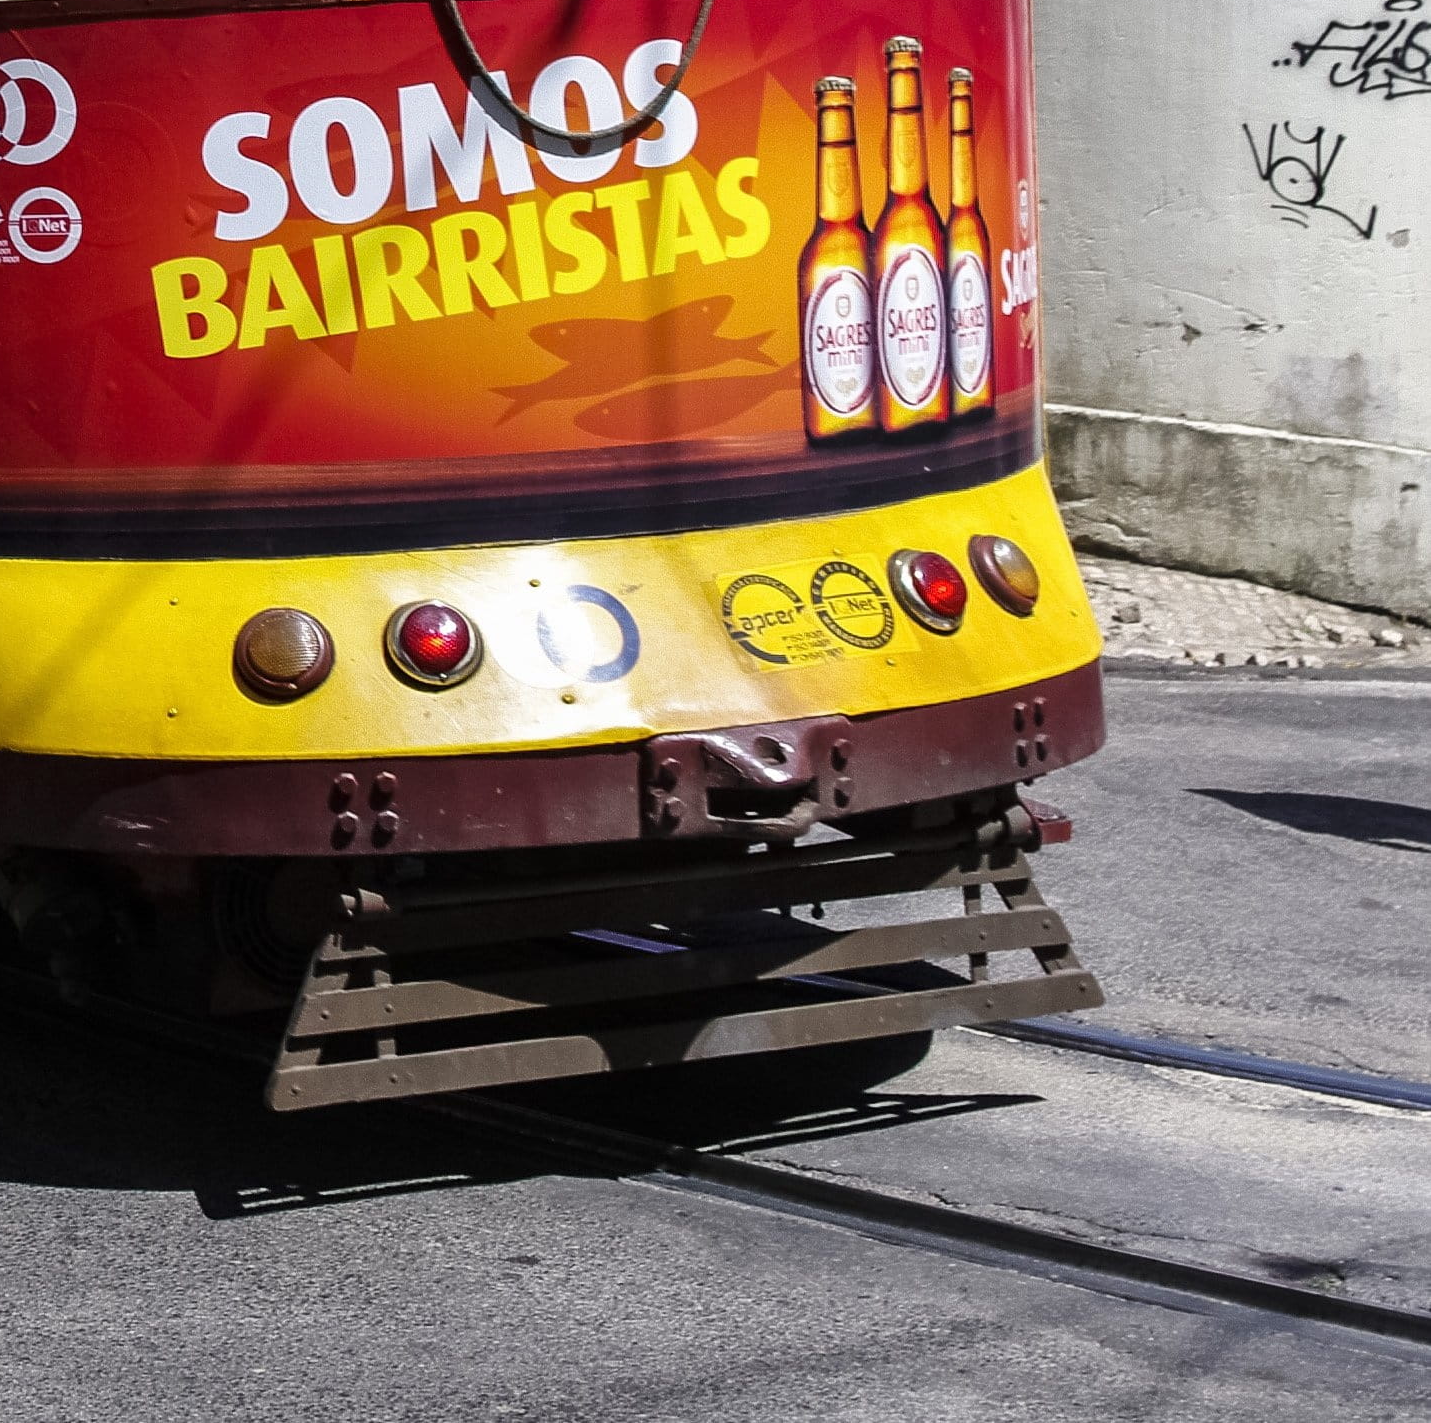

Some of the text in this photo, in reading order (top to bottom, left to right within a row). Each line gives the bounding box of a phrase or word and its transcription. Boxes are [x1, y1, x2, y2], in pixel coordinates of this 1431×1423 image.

[202, 39, 699, 241] SOMOS
[151, 157, 772, 358] BAIRRISTAS
[816, 320, 872, 352] SAGRES
[889, 304, 937, 338] SAGRES
[739, 608, 795, 634] apcer
